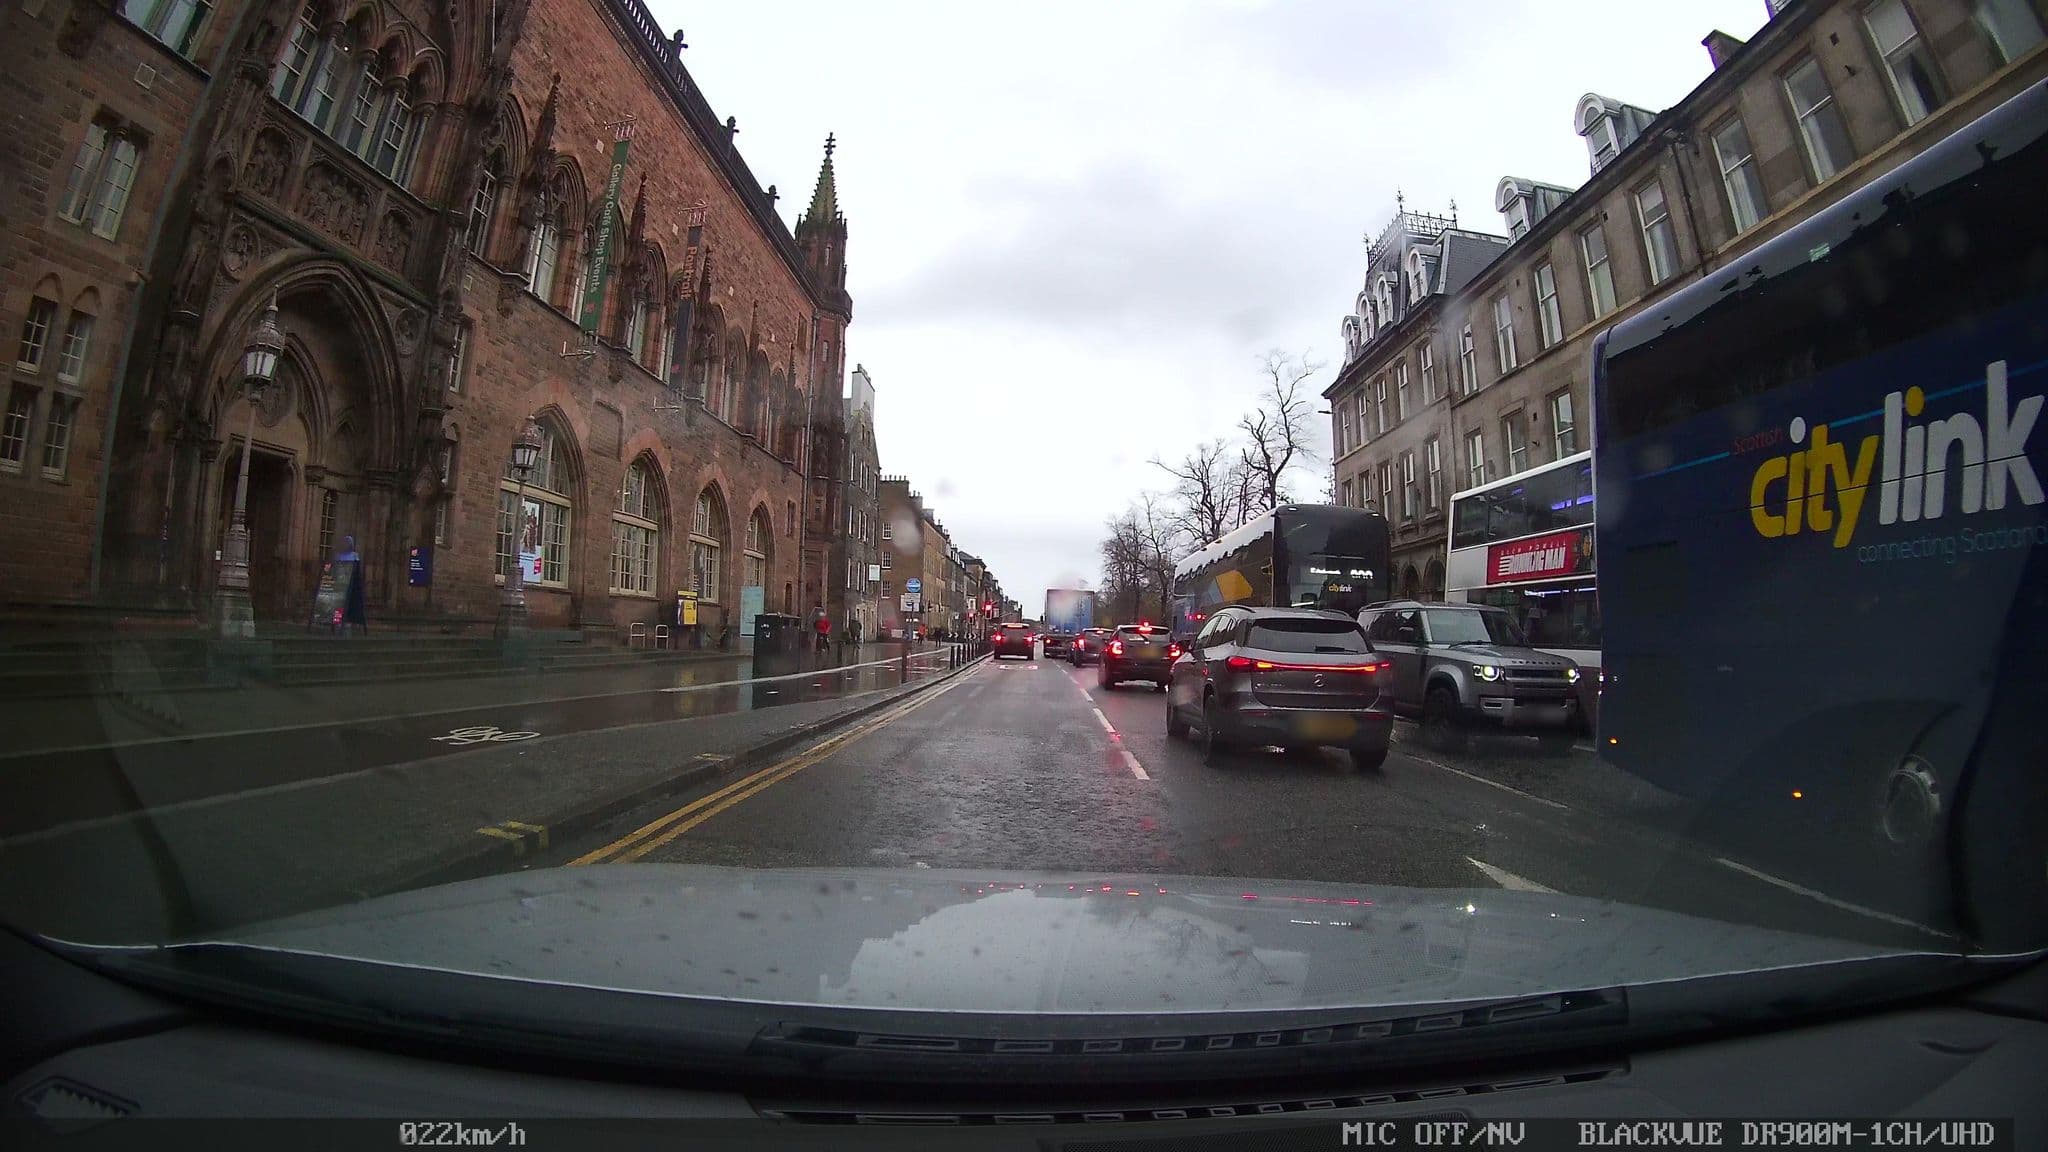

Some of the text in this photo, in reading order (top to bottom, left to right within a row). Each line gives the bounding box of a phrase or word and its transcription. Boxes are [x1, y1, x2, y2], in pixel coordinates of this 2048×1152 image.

[606, 163, 622, 200] Gallery
[595, 227, 609, 255] Shop
[590, 256, 605, 293] Events
[680, 246, 698, 300] Portrait
[1750, 359, 2046, 549] citylink
[1856, 532, 1958, 565] connecting
